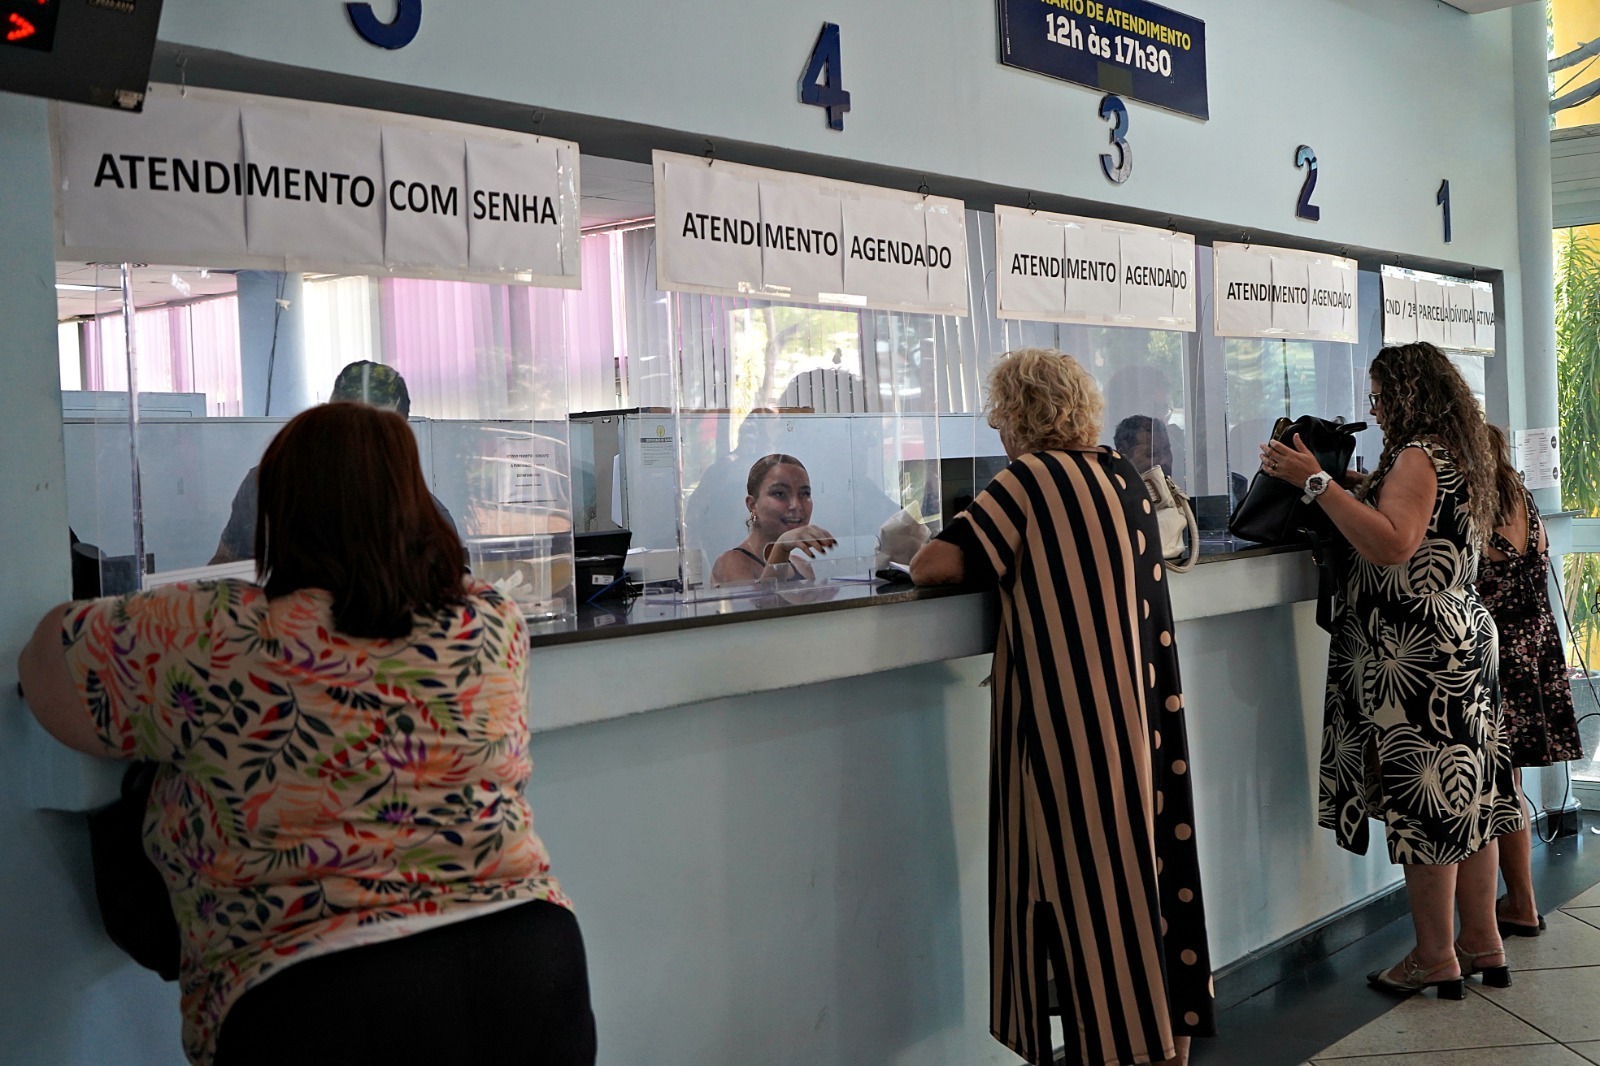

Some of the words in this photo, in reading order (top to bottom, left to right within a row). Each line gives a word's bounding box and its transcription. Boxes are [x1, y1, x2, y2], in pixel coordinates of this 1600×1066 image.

[1046, 13, 1084, 51] 12h
[1088, 25, 1111, 59] às
[1114, 35, 1172, 78] 17h30
[1087, 5, 1104, 22] DE
[1105, 10, 1191, 51] ATENDIMENTO
[798, 21, 851, 131] 4
[1098, 94, 1132, 184] 3
[94, 153, 375, 207] ATENDIMENTO
[389, 180, 458, 217] COM
[473, 189, 558, 226] SENHA
[1294, 144, 1320, 221] 2
[1437, 178, 1452, 244] 1
[682, 211, 838, 257] ATENDIMENTO
[850, 235, 952, 269] AGENDADO
[1011, 253, 1117, 283] ATENDIMENTO
[1125, 265, 1187, 290] AGENDADO
[1226, 282, 1308, 305] ATENDIMENTO
[1311, 288, 1352, 310] AGENDADO
[1385, 298, 1400, 316] CND
[1418, 304, 1450, 322] PARCELA
[1450, 304, 1474, 324] DÍVIDA
[1476, 310, 1495, 326] ATIVA
